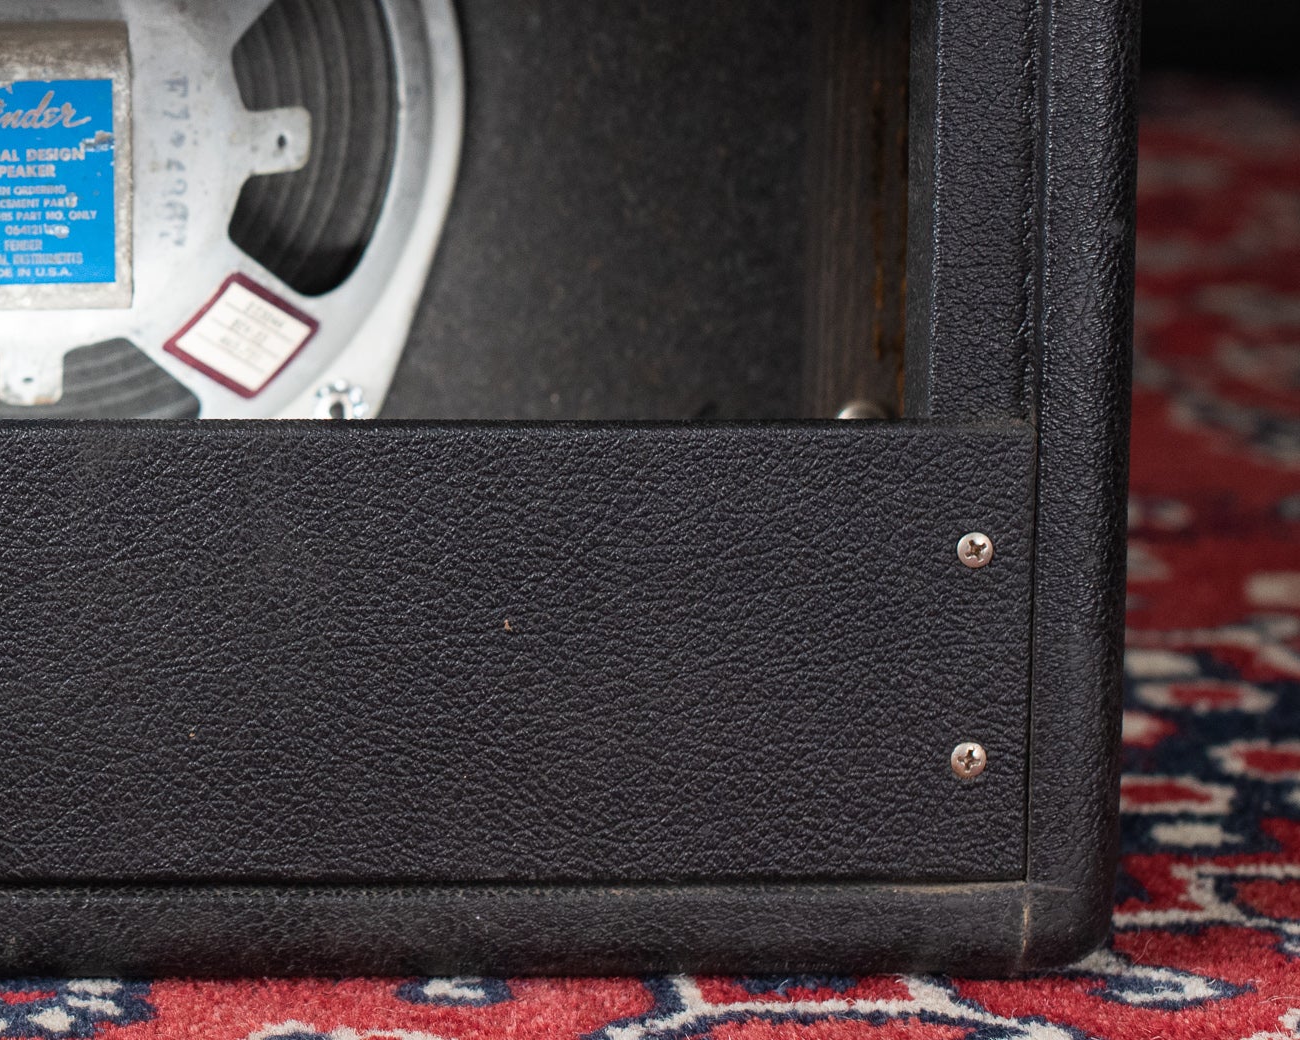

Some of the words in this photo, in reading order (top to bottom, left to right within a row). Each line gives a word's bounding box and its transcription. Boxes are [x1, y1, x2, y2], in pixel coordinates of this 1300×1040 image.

[26, 147, 85, 161] DESIGN
[13, 184, 67, 195] ORDERING
[16, 211, 42, 221] PART
[45, 210, 66, 221] NO.
[68, 210, 97, 220] ONLY
[4, 239, 43, 251] FENDER
[13, 252, 83, 265] INSTRUMENTS
[17, 267, 32, 277] IN
[35, 266, 73, 277] U.S.A.
